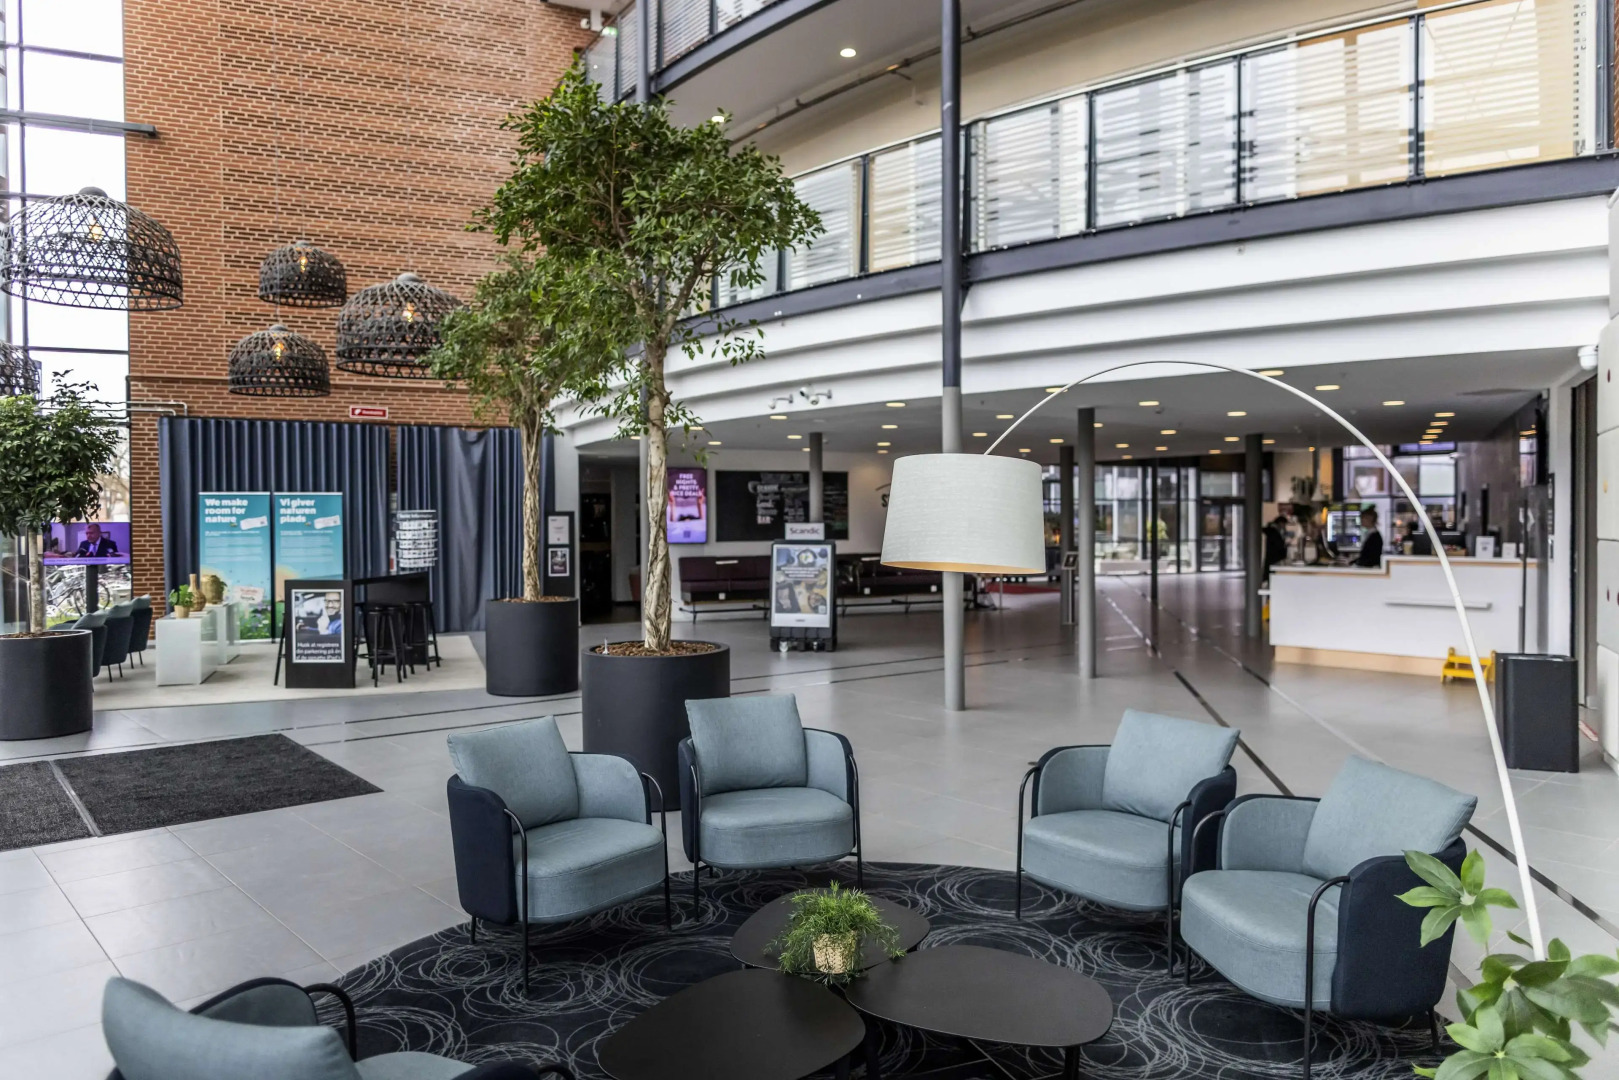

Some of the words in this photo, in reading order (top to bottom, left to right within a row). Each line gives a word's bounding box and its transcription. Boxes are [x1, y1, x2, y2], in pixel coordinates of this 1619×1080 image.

[222, 498, 248, 506] make
[291, 498, 315, 508] giver
[280, 515, 306, 524] plads
